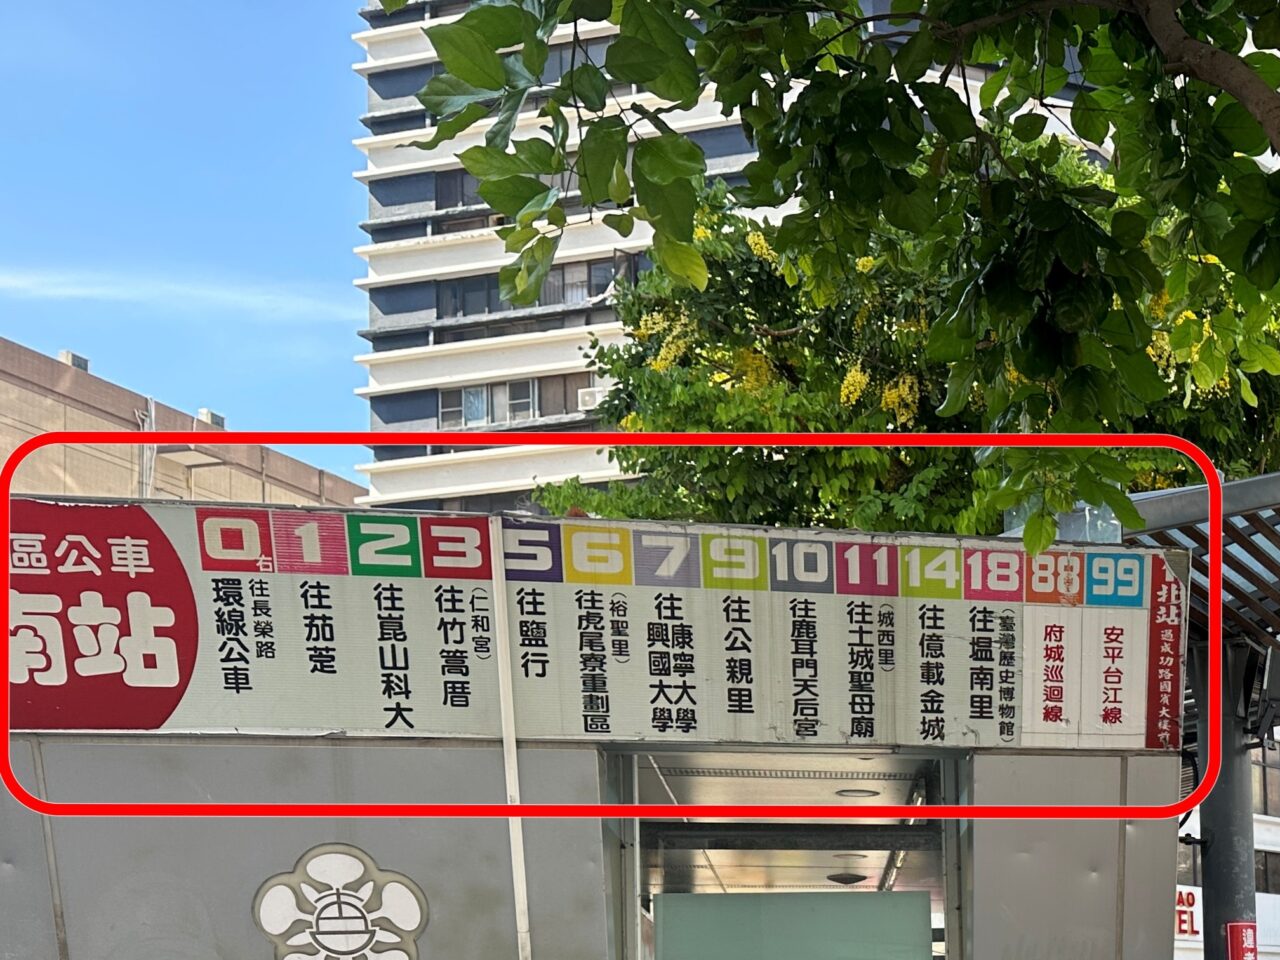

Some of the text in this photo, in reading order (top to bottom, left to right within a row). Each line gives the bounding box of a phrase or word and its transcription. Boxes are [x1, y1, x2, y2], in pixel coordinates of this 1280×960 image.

[10, 533, 154, 578] 區公車
[202, 517, 261, 560] 0
[294, 522, 322, 563] 1
[358, 522, 412, 566] 2
[430, 525, 482, 569] 3
[504, 529, 553, 571] 5
[571, 531, 624, 574] 6
[642, 535, 691, 577] 7
[709, 538, 759, 579] 9
[256, 554, 273, 572] 右
[771, 541, 828, 583] 10
[843, 545, 889, 586] 11
[905, 548, 960, 589] 14
[967, 552, 1020, 591] 18
[1031, 555, 1080, 594] 88
[1091, 557, 1140, 597] 99
[248, 579, 276, 659] 往長榮路
[299, 581, 337, 674] 往茄萣
[654, 592, 684, 620] 往
[211, 578, 253, 694] 環線公車
[434, 585, 471, 708] 往竹篙厝
[516, 587, 550, 678] 往鹽行
[722, 595, 755, 714] 往公親里
[373, 583, 415, 729] 往崑山科大
[575, 589, 611, 734] 往虎尾寮重劃區
[647, 622, 674, 733] 興國大學
[671, 623, 697, 733] 康寧大學
[789, 598, 819, 737] 往鹿耳門天后宮
[846, 600, 875, 738] 往土城聖母廟
[919, 604, 945, 741] 往億載金城
[969, 606, 995, 719] 往塭南里
[1043, 624, 1064, 722] 府城巡迴線
[1102, 626, 1124, 724] 安平台江線
[1177, 891, 1195, 907] AO
[1177, 910, 1199, 935] EL
